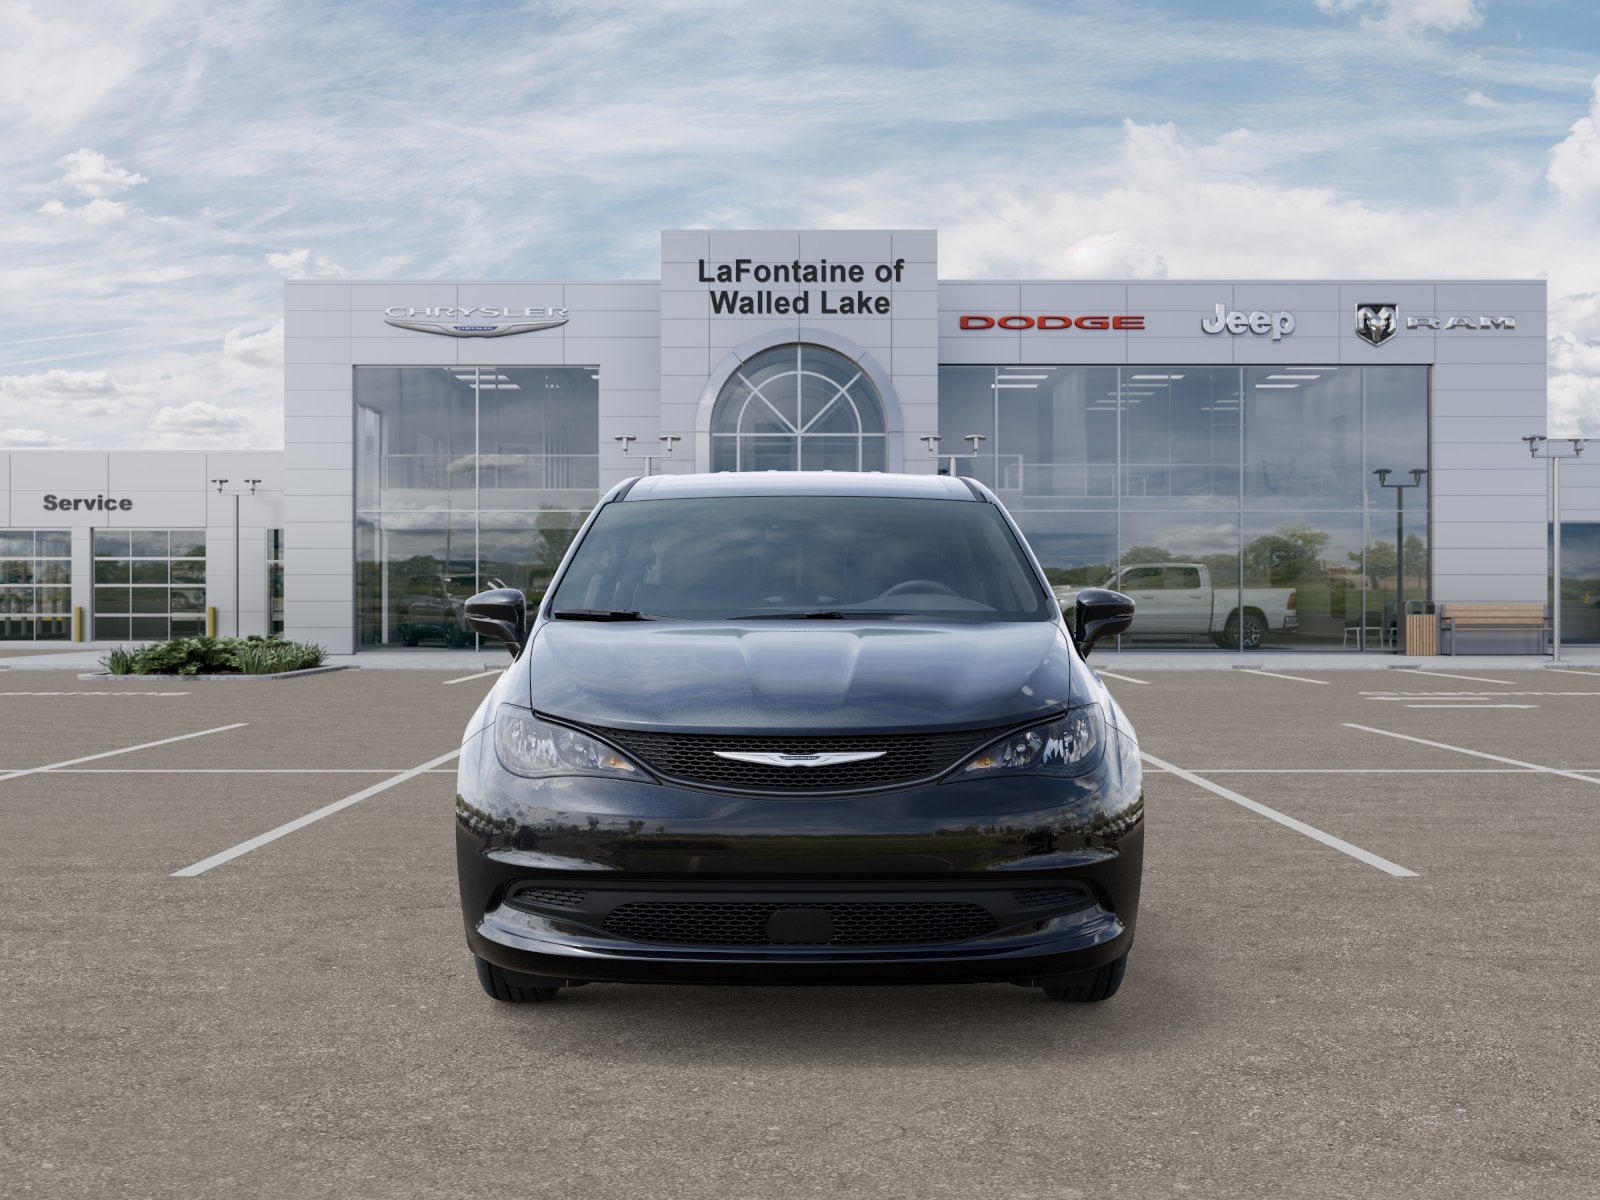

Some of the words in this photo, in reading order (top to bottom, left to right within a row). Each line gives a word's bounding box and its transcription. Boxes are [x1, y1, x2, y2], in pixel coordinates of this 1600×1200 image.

[699, 259, 864, 282] LaFontaine
[875, 259, 904, 282] of
[710, 291, 809, 314] Walled
[821, 291, 890, 314] Lake
[384, 306, 568, 317] CHRYSLER
[960, 315, 1145, 329] DODGE
[1201, 303, 1295, 341] Jeep
[1406, 316, 1515, 329] RAM
[43, 494, 133, 511] Service
